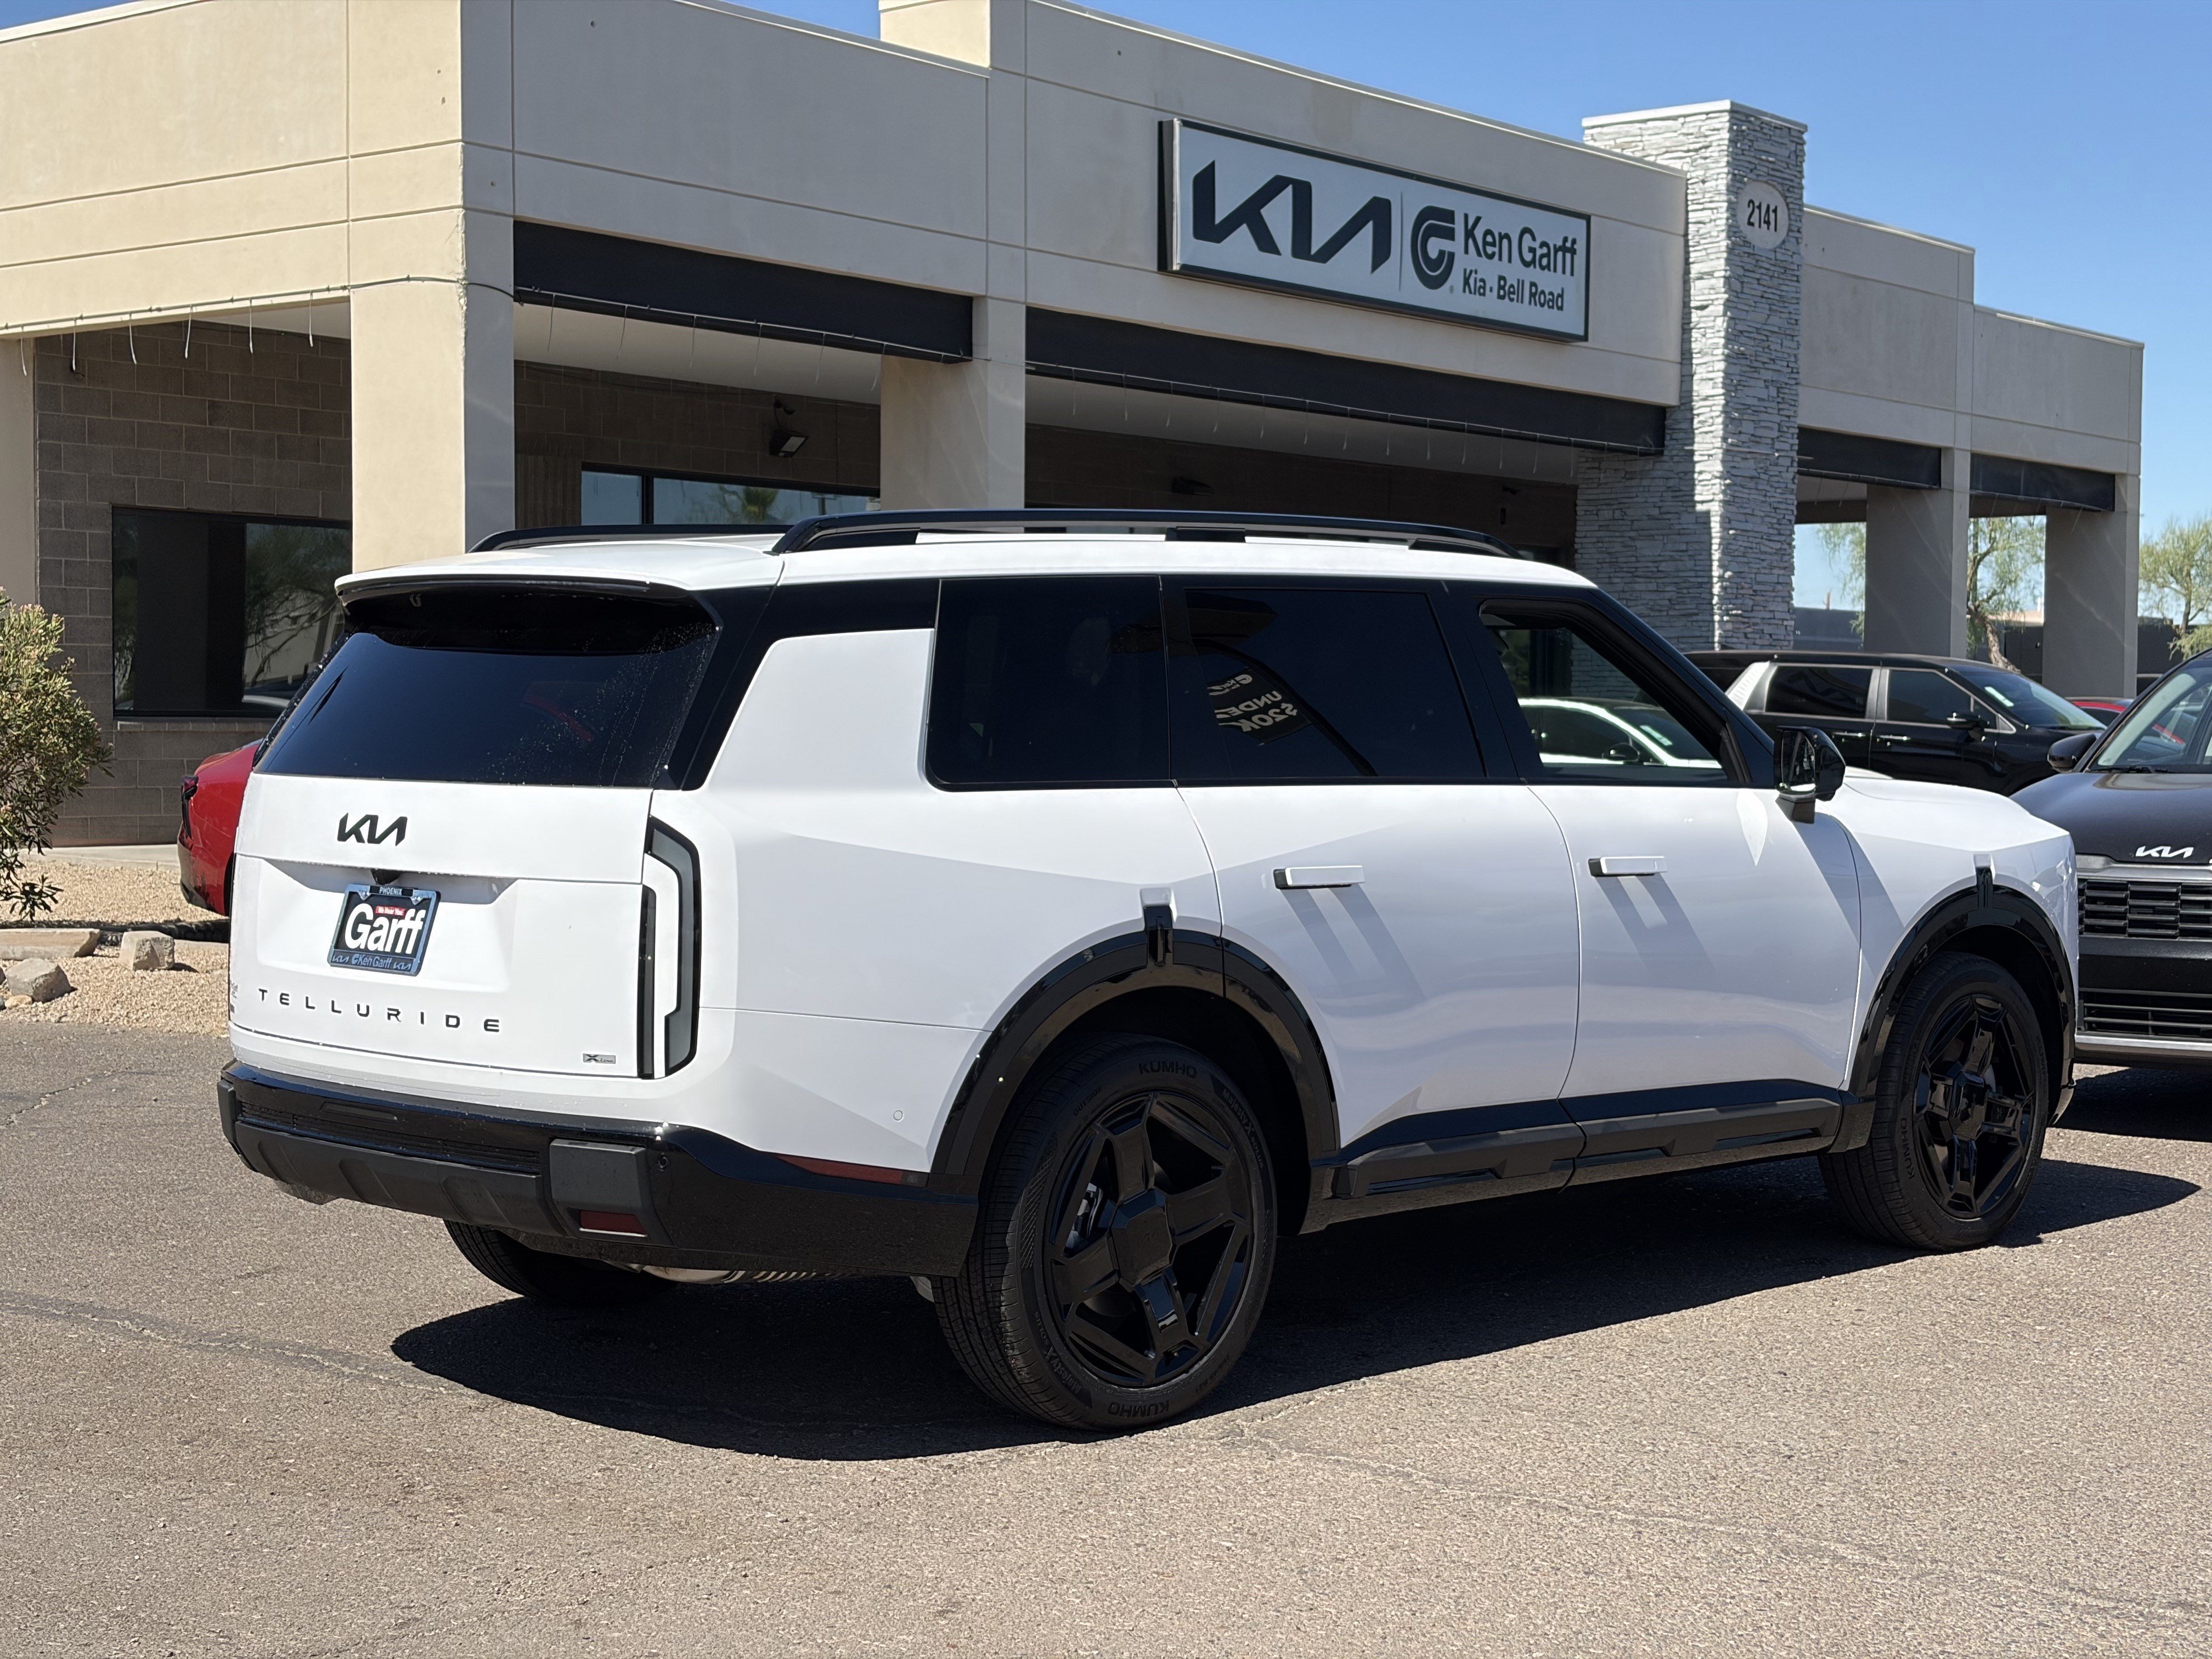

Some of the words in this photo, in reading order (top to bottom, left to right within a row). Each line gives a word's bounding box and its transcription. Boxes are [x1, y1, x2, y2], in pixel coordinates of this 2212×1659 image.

[1747, 199, 1778, 232] 2141
[1463, 212, 1513, 264] Ken
[1517, 226, 1577, 278] Garff
[1462, 268, 1486, 298] Kia
[1497, 274, 1524, 305] Bell
[1529, 279, 1565, 312] Road
[379, 887, 403, 895] PHOENIX
[345, 903, 426, 954] Garff
[359, 955, 373, 967] Ken
[372, 956, 392, 968] Garff
[258, 988, 500, 1032] TELLURIDE
[1139, 1060, 1197, 1079] KUMHO
[1900, 1117, 1915, 1180] KUMHO
[1108, 1400, 1169, 1417] KUMHO
